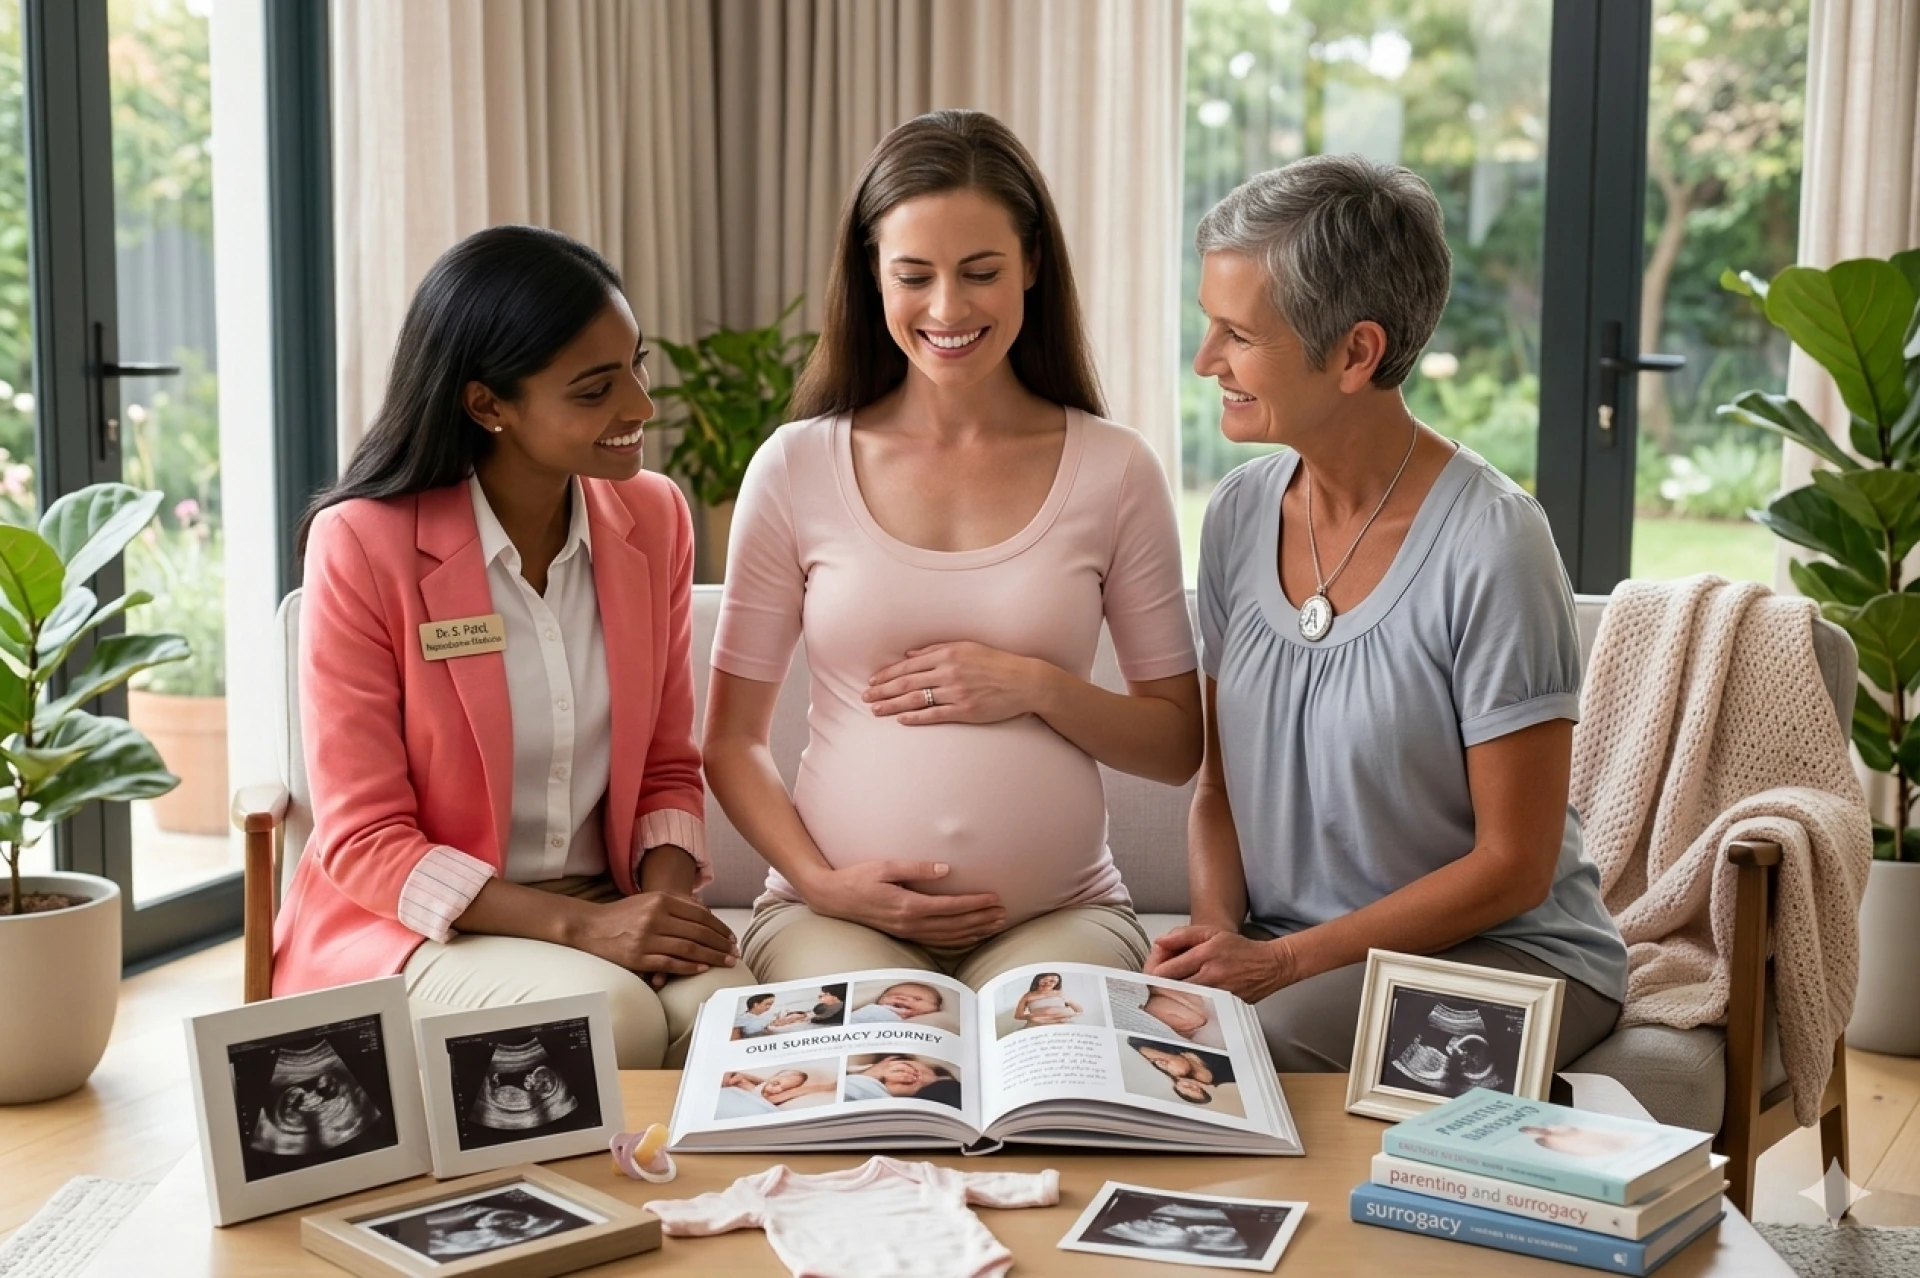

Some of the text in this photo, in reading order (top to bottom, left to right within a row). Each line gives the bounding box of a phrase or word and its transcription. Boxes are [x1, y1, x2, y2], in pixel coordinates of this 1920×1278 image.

[436, 628, 450, 639] Dr.
[452, 626, 460, 637] S.
[875, 1030, 943, 1043] JOURNEY
[1389, 1169, 1467, 1199] parenting
[1472, 1187, 1501, 1203] and
[1505, 1193, 1589, 1226] surrogacy
[1366, 1201, 1462, 1235] surrogacy
